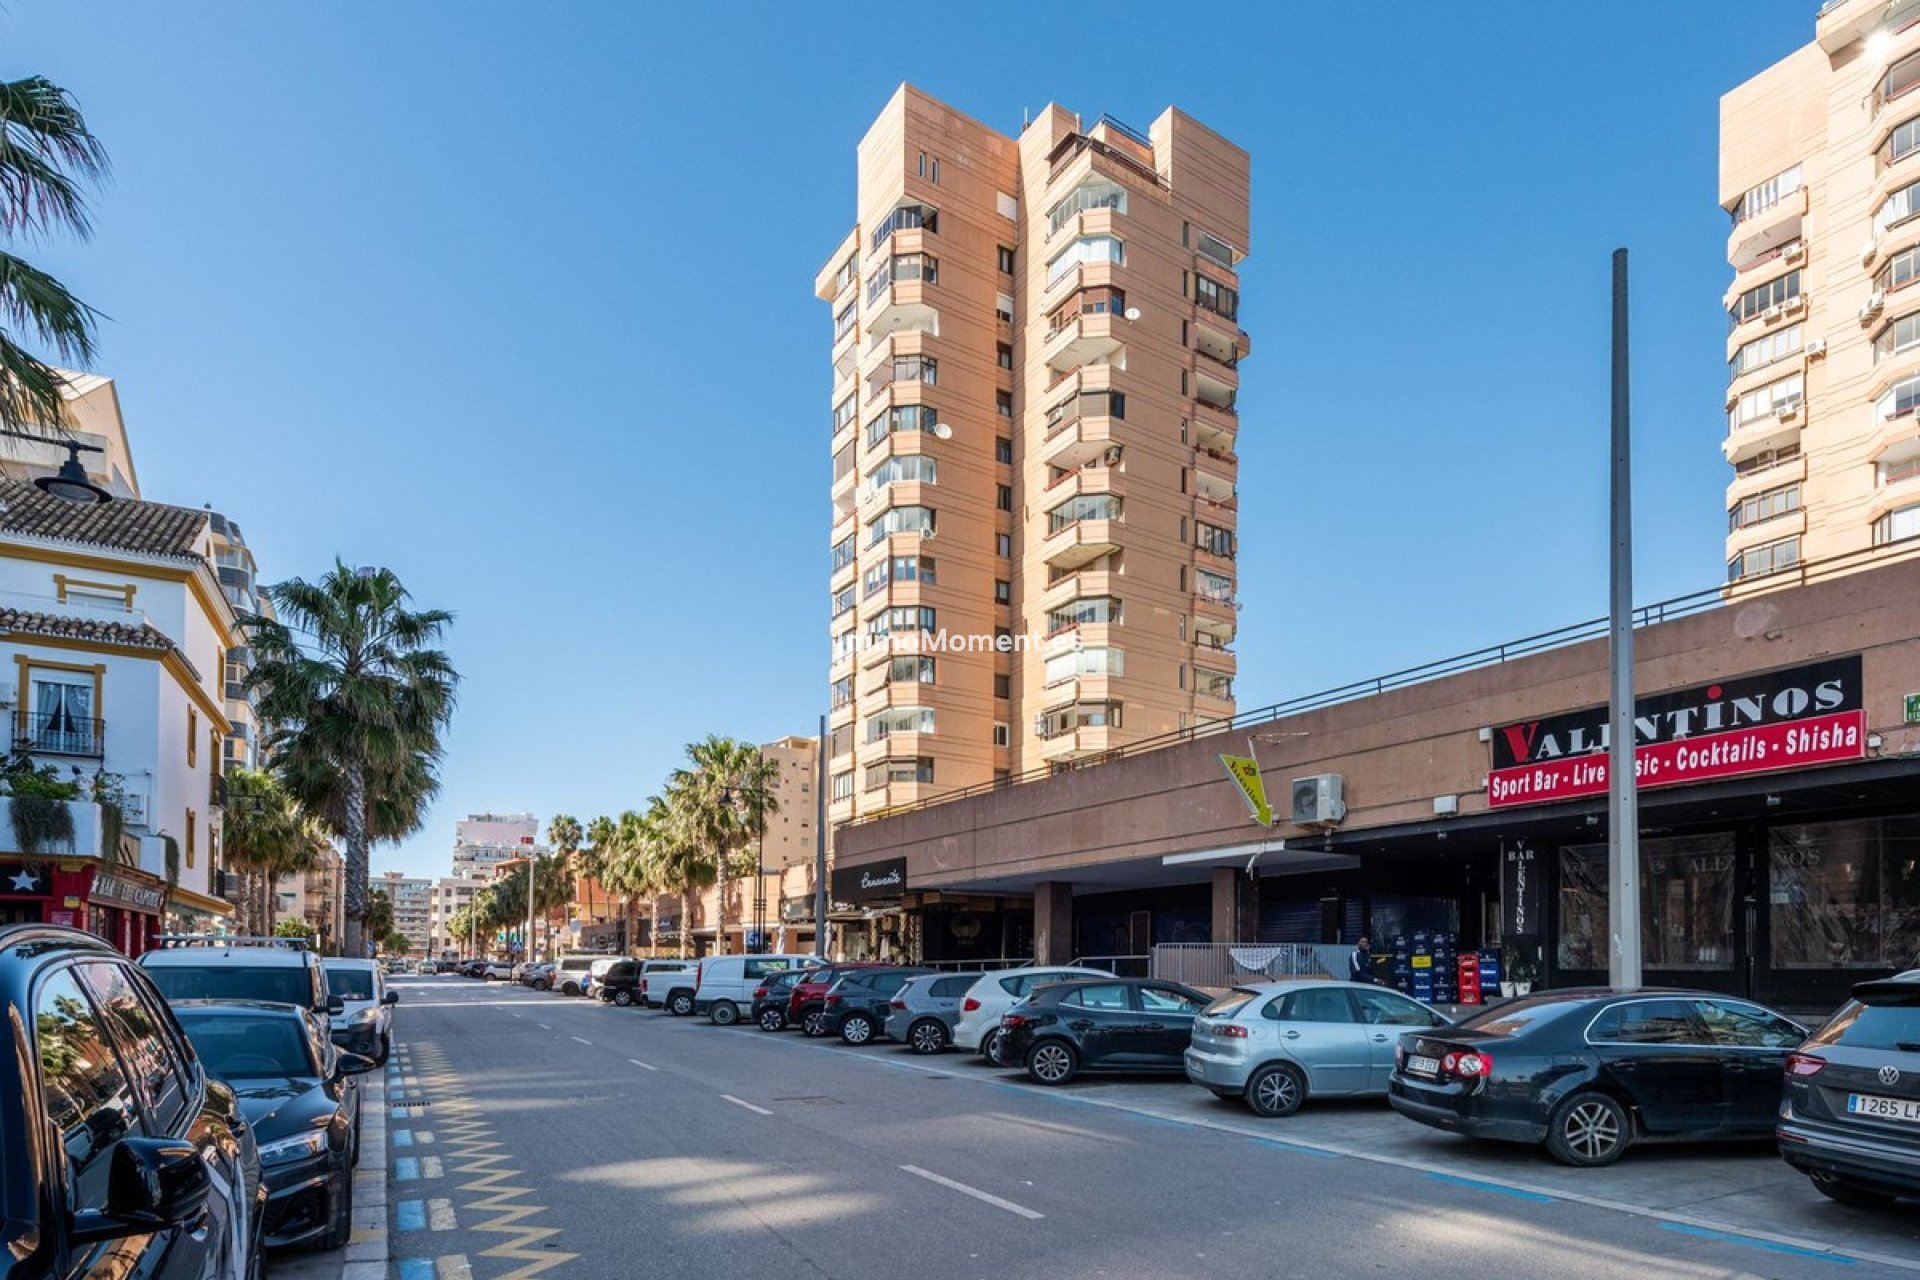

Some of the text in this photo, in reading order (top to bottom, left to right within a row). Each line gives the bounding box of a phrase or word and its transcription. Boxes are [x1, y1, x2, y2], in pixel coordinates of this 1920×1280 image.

[1492, 773, 1530, 801] Sport
[1534, 770, 1559, 791] Bar
[1573, 763, 1606, 786] Live
[1677, 735, 1766, 770] Cocktails
[1785, 722, 1857, 755] Shisha
[1861, 1098, 1898, 1116] 1265
